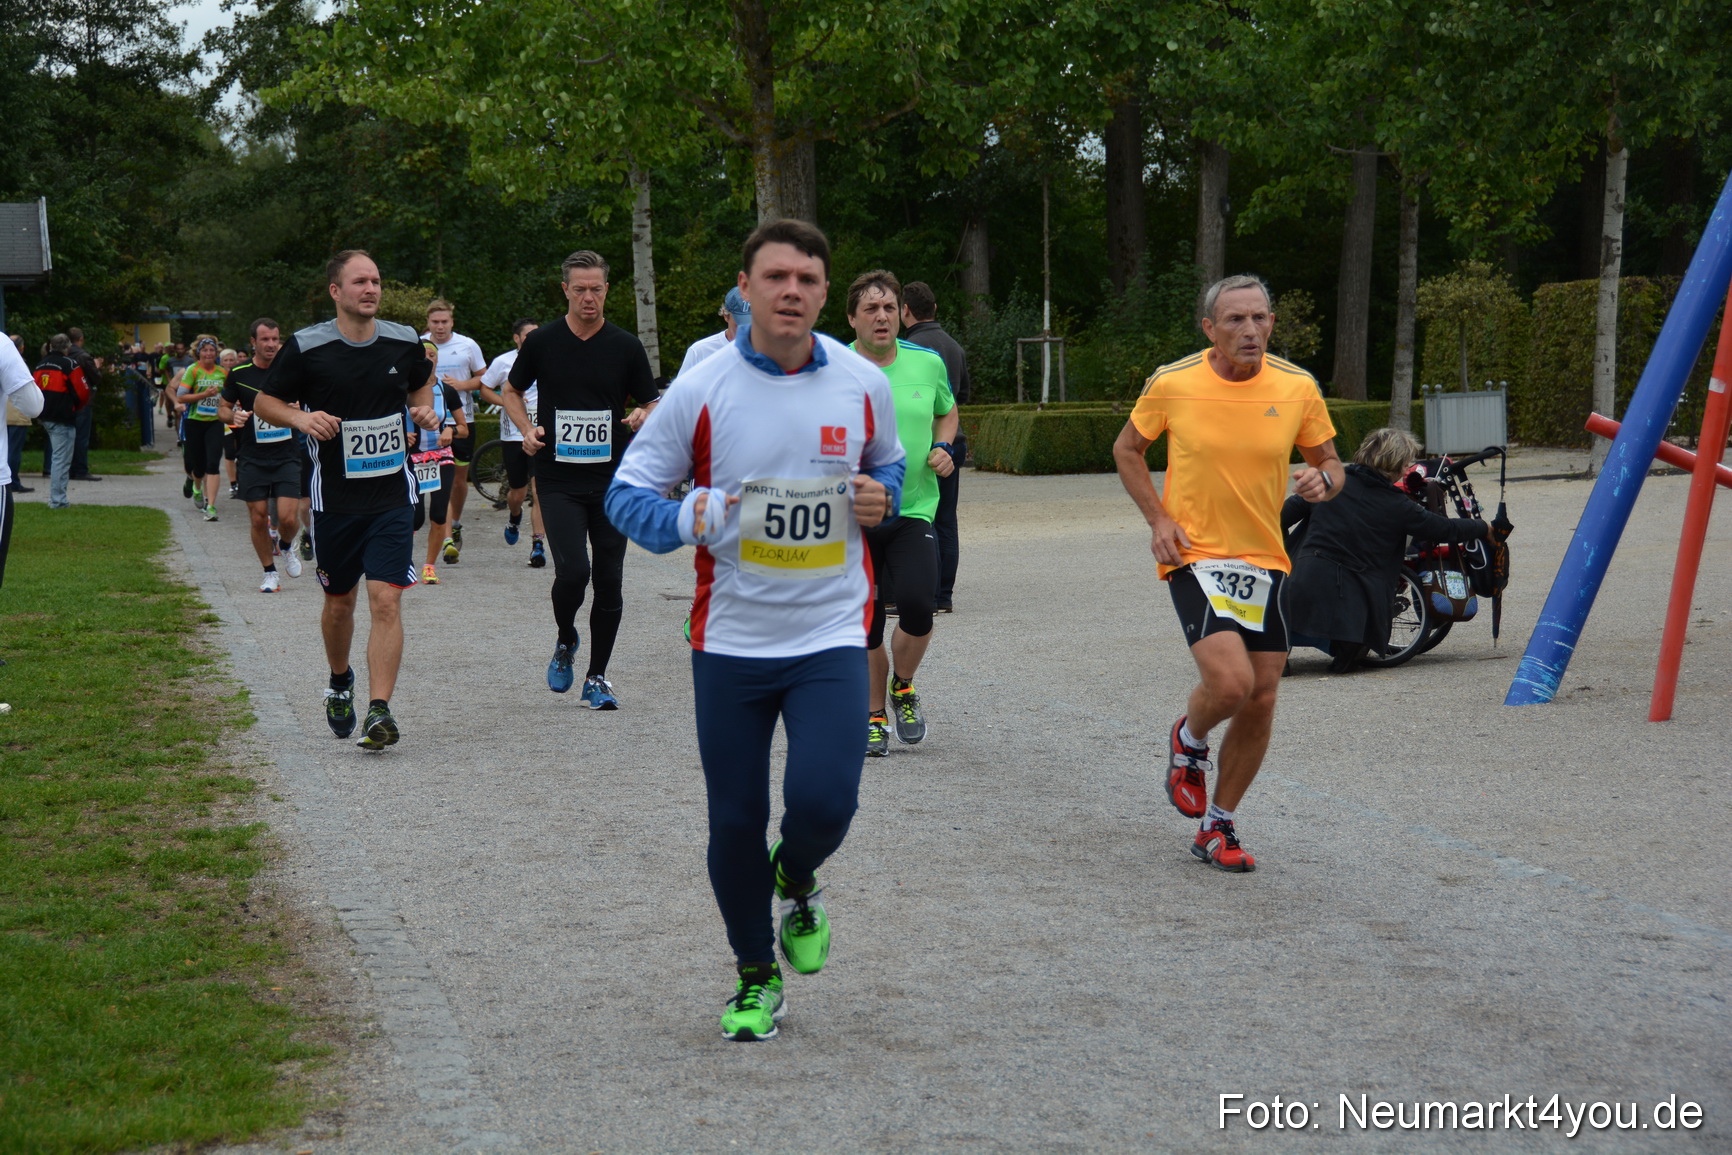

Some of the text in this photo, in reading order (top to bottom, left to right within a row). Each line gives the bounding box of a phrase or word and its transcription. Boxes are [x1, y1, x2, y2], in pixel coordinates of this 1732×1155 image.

[368, 422, 395, 431] Neumarkt
[561, 423, 608, 443] 2766
[351, 429, 401, 456] 2025
[567, 447, 601, 456] Christian
[361, 458, 395, 470] Andreas
[745, 485, 834, 499] PARTL Neumarkt
[764, 502, 831, 541] 509
[752, 545, 811, 562] FLORIAN
[1223, 562, 1258, 573] Neumarkt
[1210, 571, 1257, 600] 333
